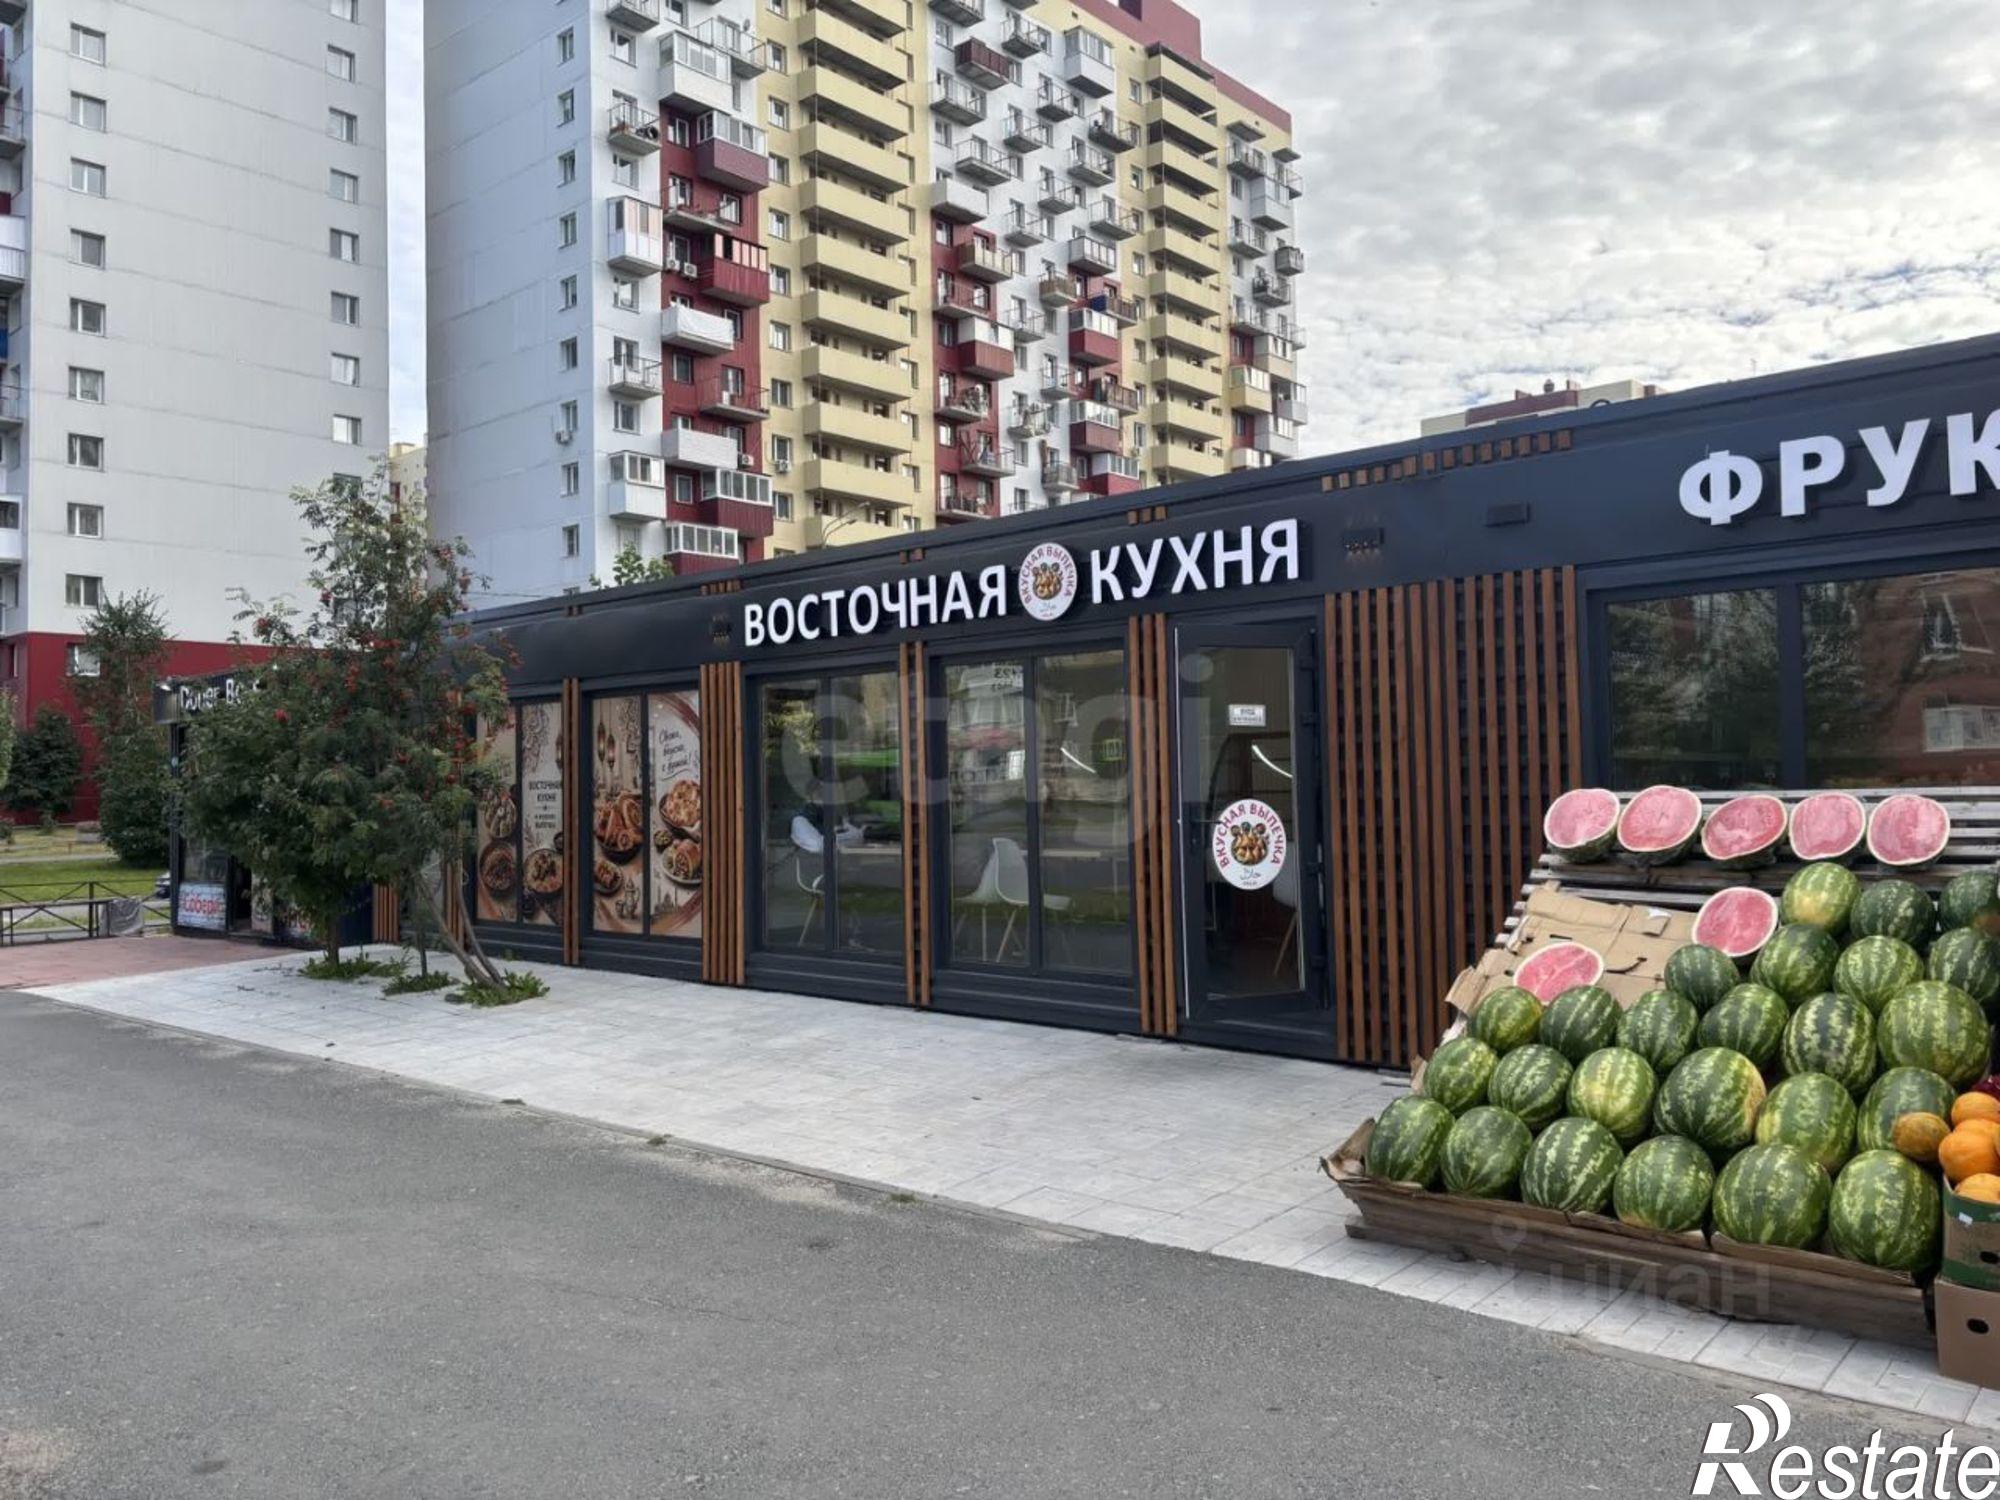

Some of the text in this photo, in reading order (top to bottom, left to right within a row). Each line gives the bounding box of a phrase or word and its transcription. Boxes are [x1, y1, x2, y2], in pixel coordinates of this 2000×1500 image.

[1678, 409, 2000, 526] ФРУК
[744, 518, 1300, 647] ВОСТОЧНАЯ КУХНЯ
[1020, 545, 1074, 604] ВКУСНАЯ ВЫПЕЧКА
[1216, 803, 1284, 868] ВКУСНАЯ ВЫПЕЧКА
